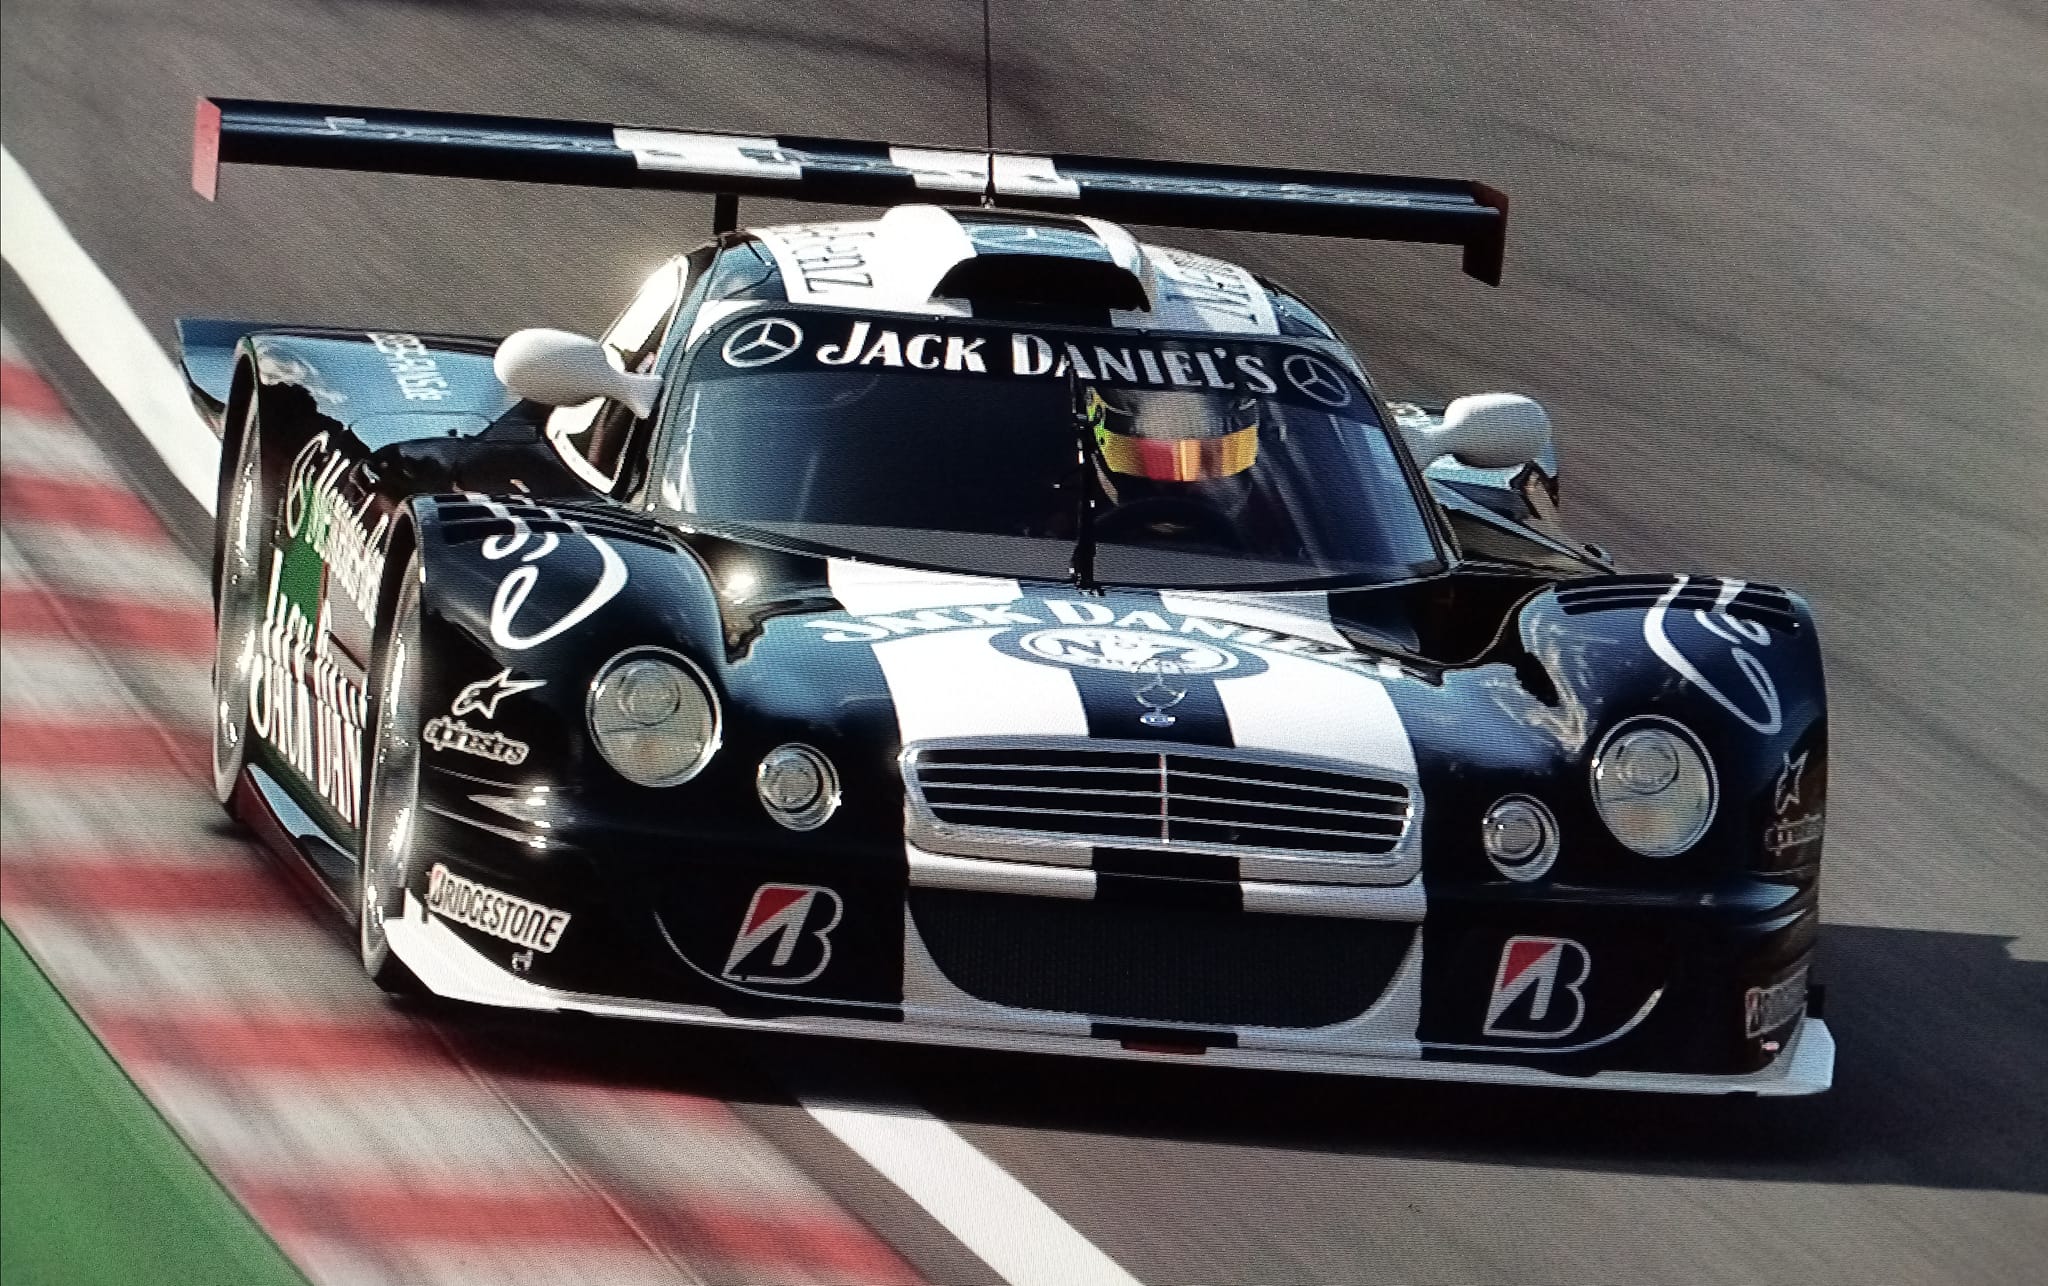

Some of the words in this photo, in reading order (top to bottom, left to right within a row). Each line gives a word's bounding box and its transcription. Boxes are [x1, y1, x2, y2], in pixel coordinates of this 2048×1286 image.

[816, 320, 989, 374] JACK
[1011, 331, 1279, 394] DANIEL'S
[429, 868, 566, 949] BRIDGESTONE
